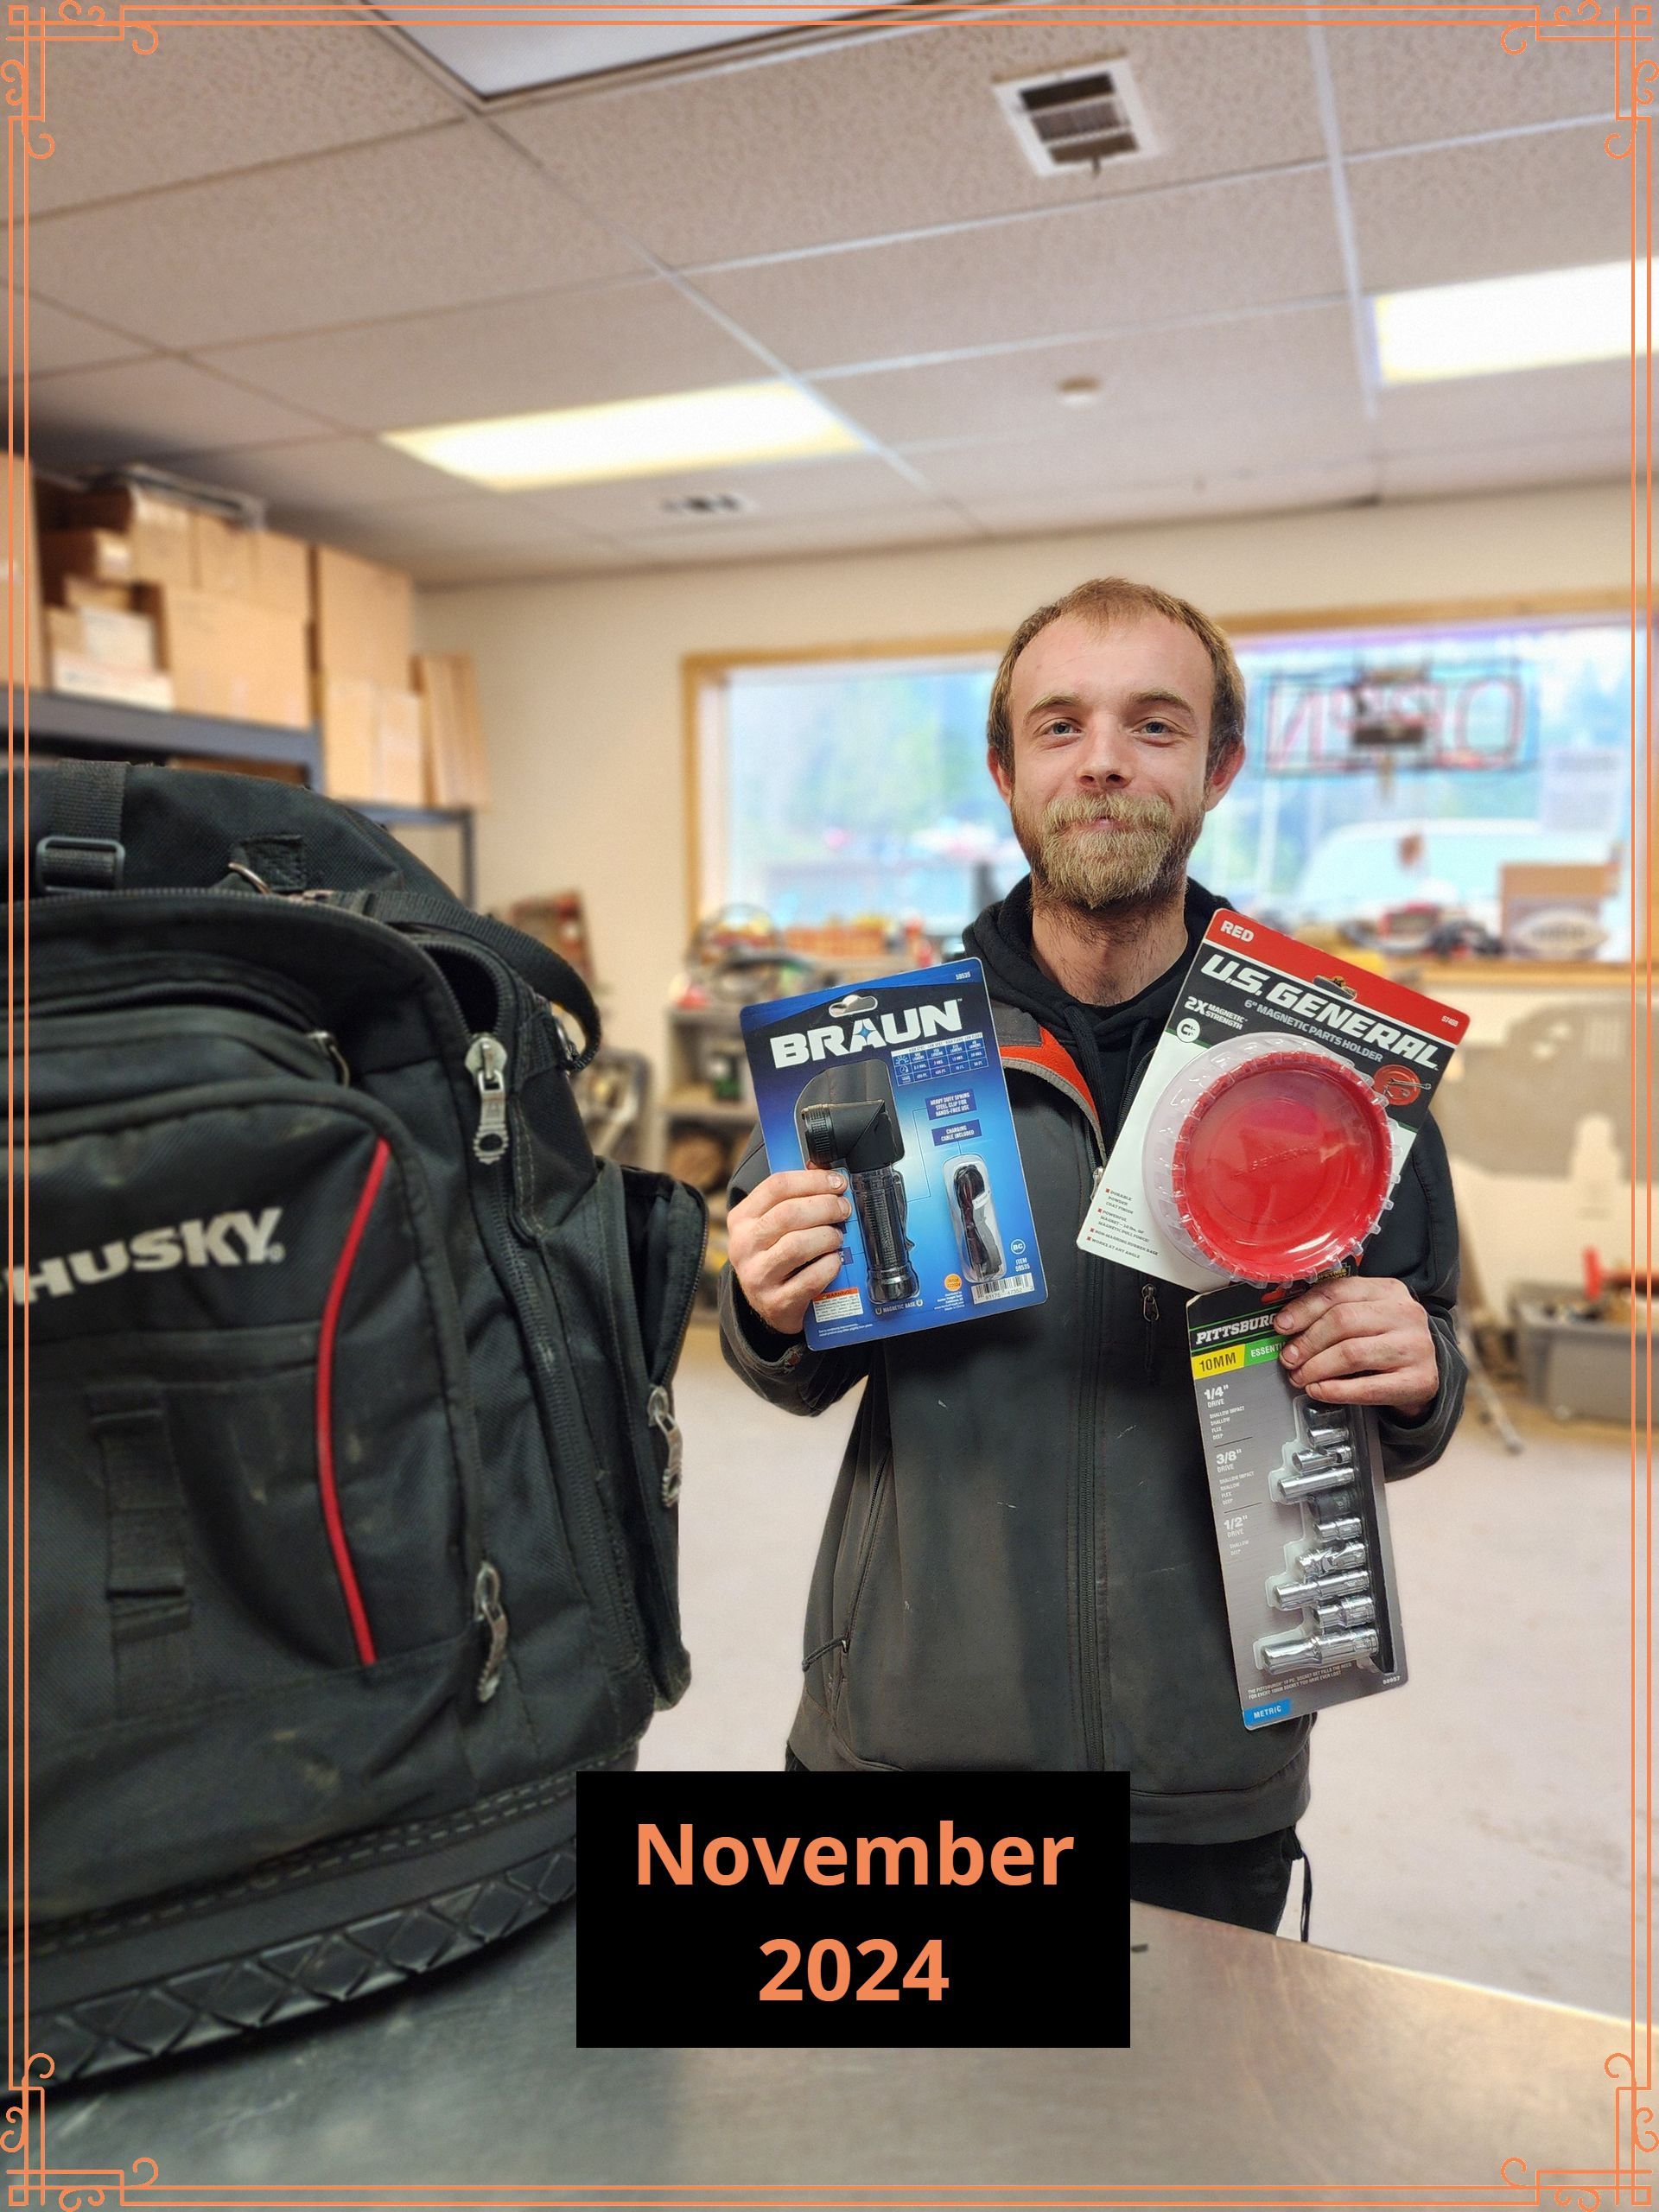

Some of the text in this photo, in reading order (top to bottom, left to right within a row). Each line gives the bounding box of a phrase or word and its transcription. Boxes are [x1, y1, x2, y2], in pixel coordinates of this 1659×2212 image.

[1220, 919, 1254, 943] RED
[1184, 995, 1209, 1015] 2X
[1200, 953, 1438, 1069] U.S. GENERAL
[1205, 1010, 1243, 1030] STRENGTH
[770, 1000, 962, 1069] BRAUN
[1257, 1004, 1309, 1033] MAGNETIC
[1308, 1025, 1344, 1046] PARTS
[1342, 1039, 1383, 1063] HOLDER
[3, 1207, 282, 1306] HUSKY
[883, 1304, 904, 1313] MAGNETIC
[1250, 1342, 1286, 1357] ESSENTI
[1199, 1352, 1236, 1372] 10MM
[1204, 1384, 1229, 1400] 1/4"
[1207, 1398, 1224, 1408] DRIVE
[1216, 1448, 1243, 1465] 3/8"
[1217, 1463, 1235, 1473] DRIVE
[1224, 1514, 1248, 1530] 1/2"
[1227, 1528, 1244, 1538] DRIVE
[1254, 1705, 1281, 1719] METRIC
